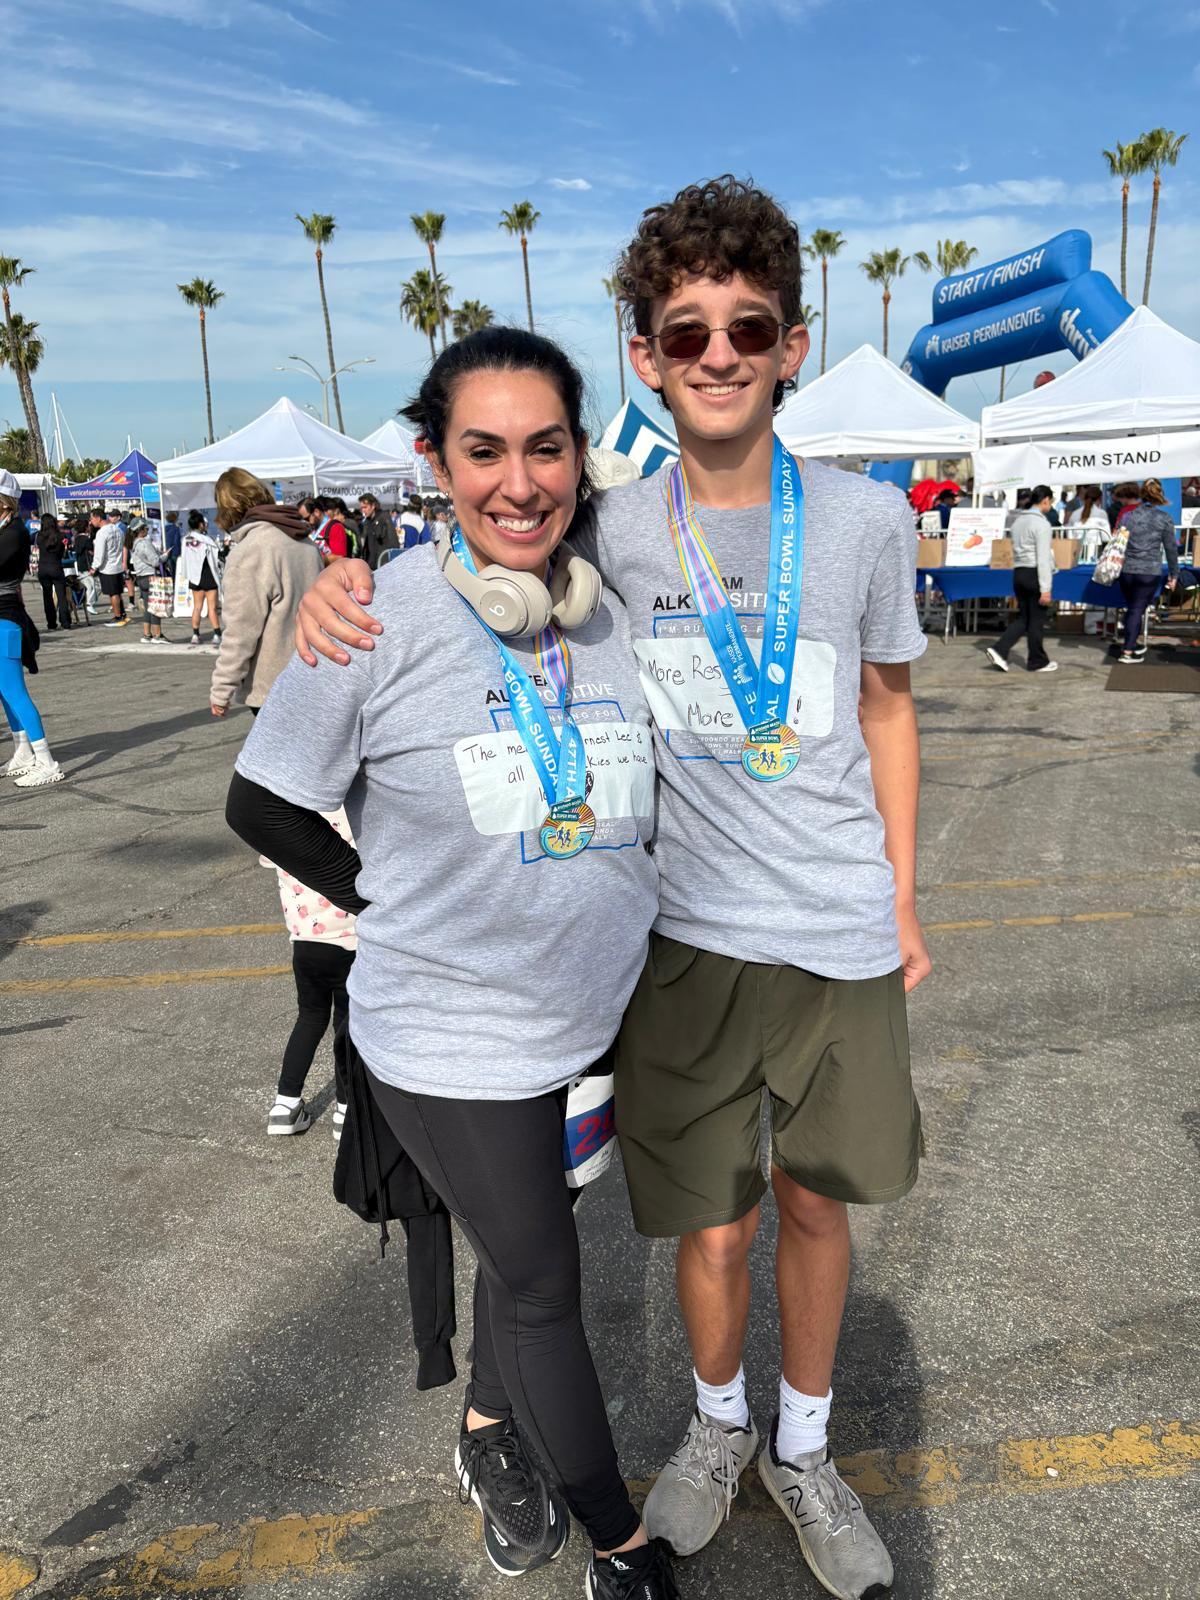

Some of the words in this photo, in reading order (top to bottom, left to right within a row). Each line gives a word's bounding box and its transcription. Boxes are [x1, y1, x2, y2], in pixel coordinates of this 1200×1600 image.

[939, 273, 985, 304] START
[991, 248, 1046, 288] FINISH
[941, 331, 971, 354] KAISER
[1048, 454, 1096, 470] FARM
[1101, 450, 1162, 467] STAND
[69, 489, 126, 497] venicefamilyclinic.org
[781, 459, 795, 525] SUNDAY
[779, 529, 794, 584] BOWL
[722, 576, 743, 590] AM
[774, 589, 791, 652] SUPER
[647, 658, 686, 686] More
[504, 670, 533, 721] BOWL
[529, 722, 559, 786] SUNDA
[687, 701, 734, 728] More
[462, 743, 497, 764] The
[584, 731, 610, 746] rnest
[614, 730, 632, 742] Lee
[567, 737, 578, 783] 47TH
[507, 764, 525, 784] all
[617, 755, 630, 764] we
